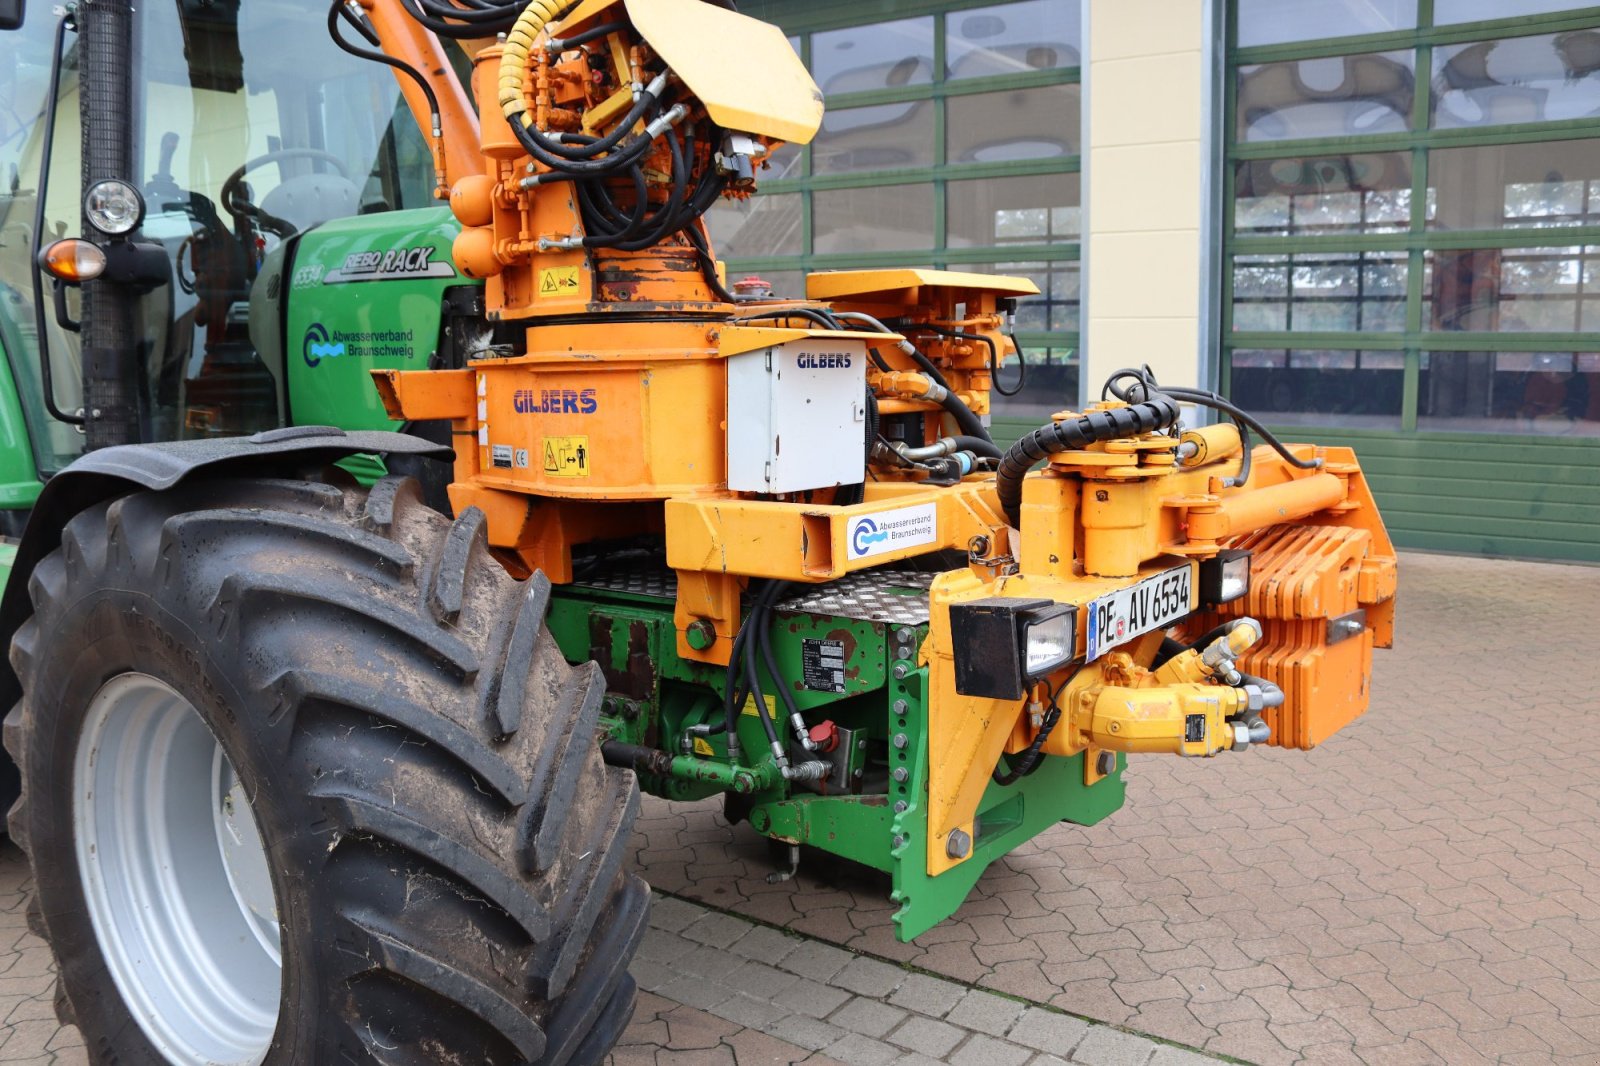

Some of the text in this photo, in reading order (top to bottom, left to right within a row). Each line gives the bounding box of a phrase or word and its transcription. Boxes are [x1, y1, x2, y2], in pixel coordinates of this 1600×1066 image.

[379, 246, 434, 273] RACK
[332, 329, 413, 343] Abwasserverband
[348, 344, 414, 360] Braunschweig
[797, 352, 851, 369] GILBERS
[513, 388, 598, 414] GILBERS
[879, 514, 932, 532] Abwasserverband
[891, 526, 932, 540] Braunschweig
[1098, 571, 1189, 648] PE AV 6534
